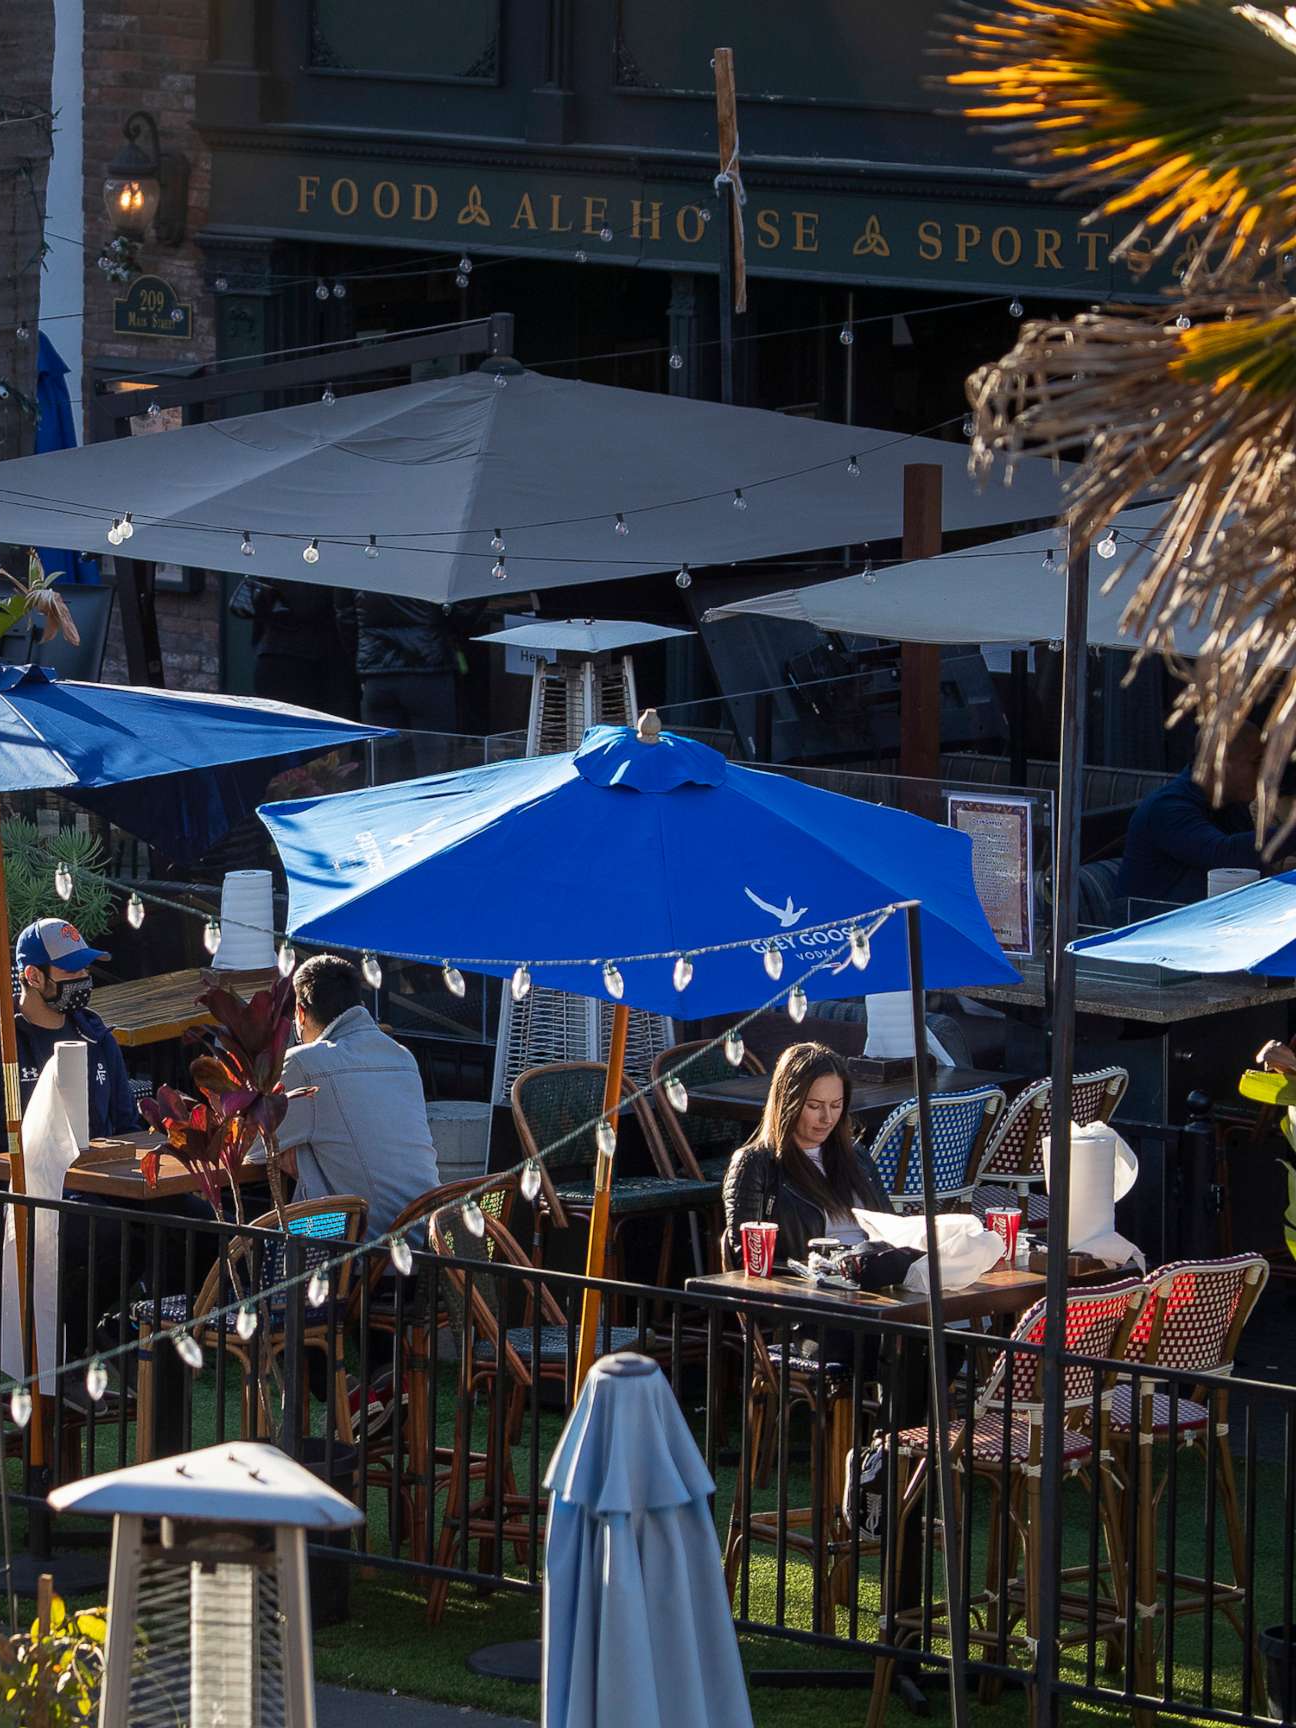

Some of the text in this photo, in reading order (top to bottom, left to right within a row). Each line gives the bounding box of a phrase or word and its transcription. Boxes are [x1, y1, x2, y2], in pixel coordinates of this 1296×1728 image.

[297, 175, 439, 222] FOOD
[630, 200, 820, 253] HOSE
[140, 289, 164, 312] 209
[799, 926, 853, 946] GOOS
[796, 948, 839, 961] VODKA
